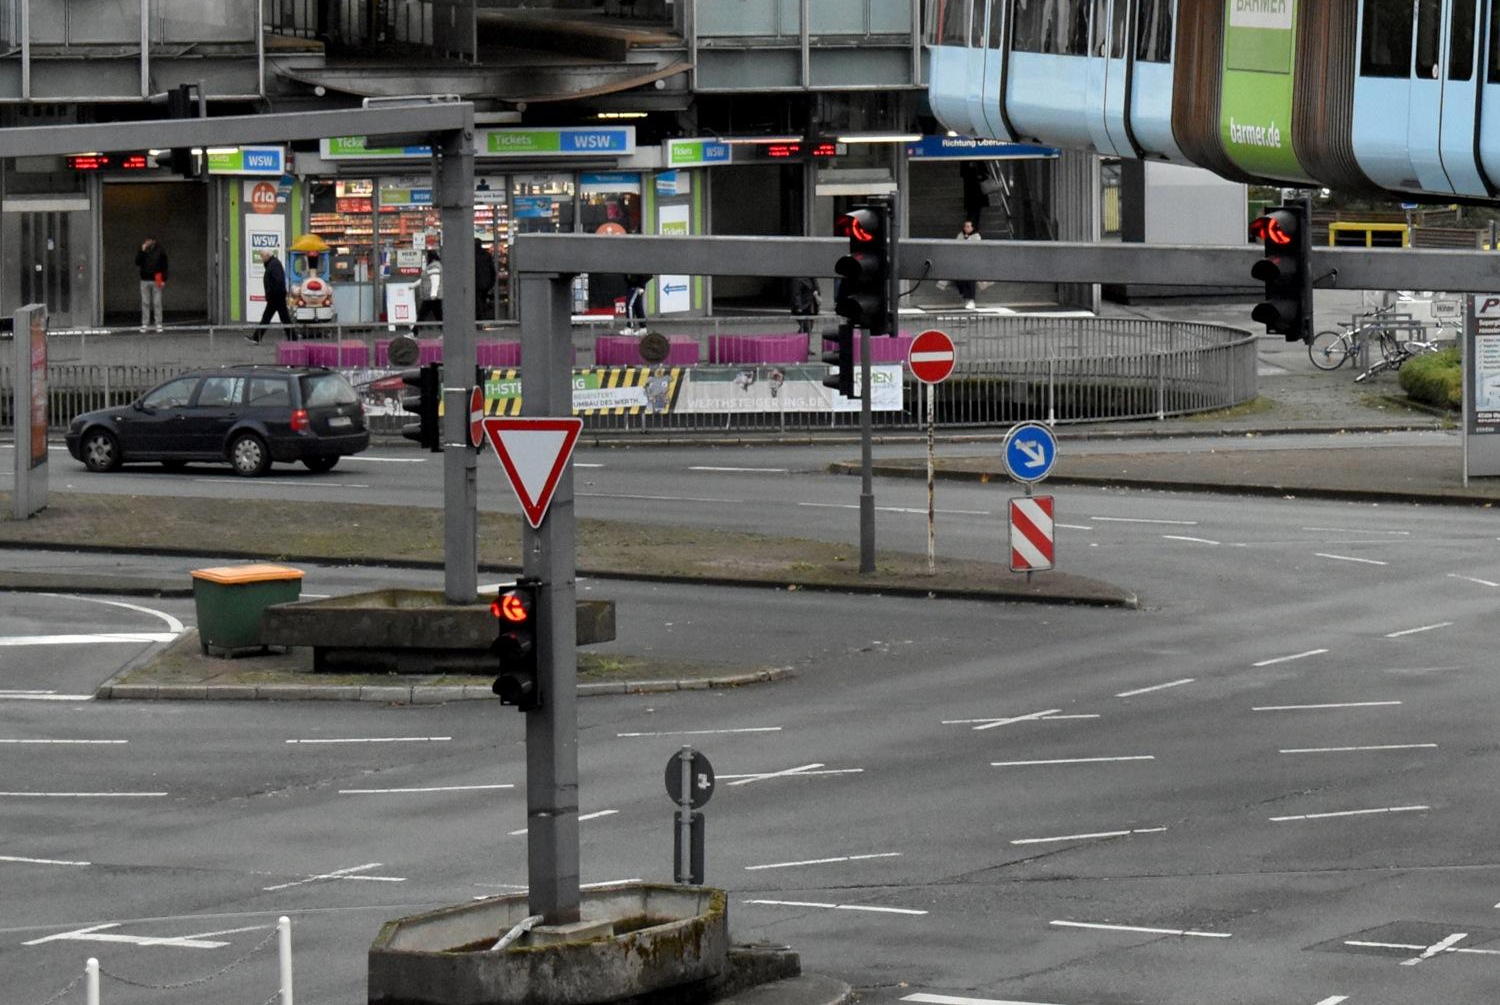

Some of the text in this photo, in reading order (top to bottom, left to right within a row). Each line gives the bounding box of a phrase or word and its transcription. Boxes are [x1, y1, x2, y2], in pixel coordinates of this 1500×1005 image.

[1230, 117, 1281, 148] barmer.de
[494, 134, 532, 145] Tickets
[942, 139, 976, 148] Richtung
[253, 186, 274, 202] ria
[599, 398, 612, 406] DES
